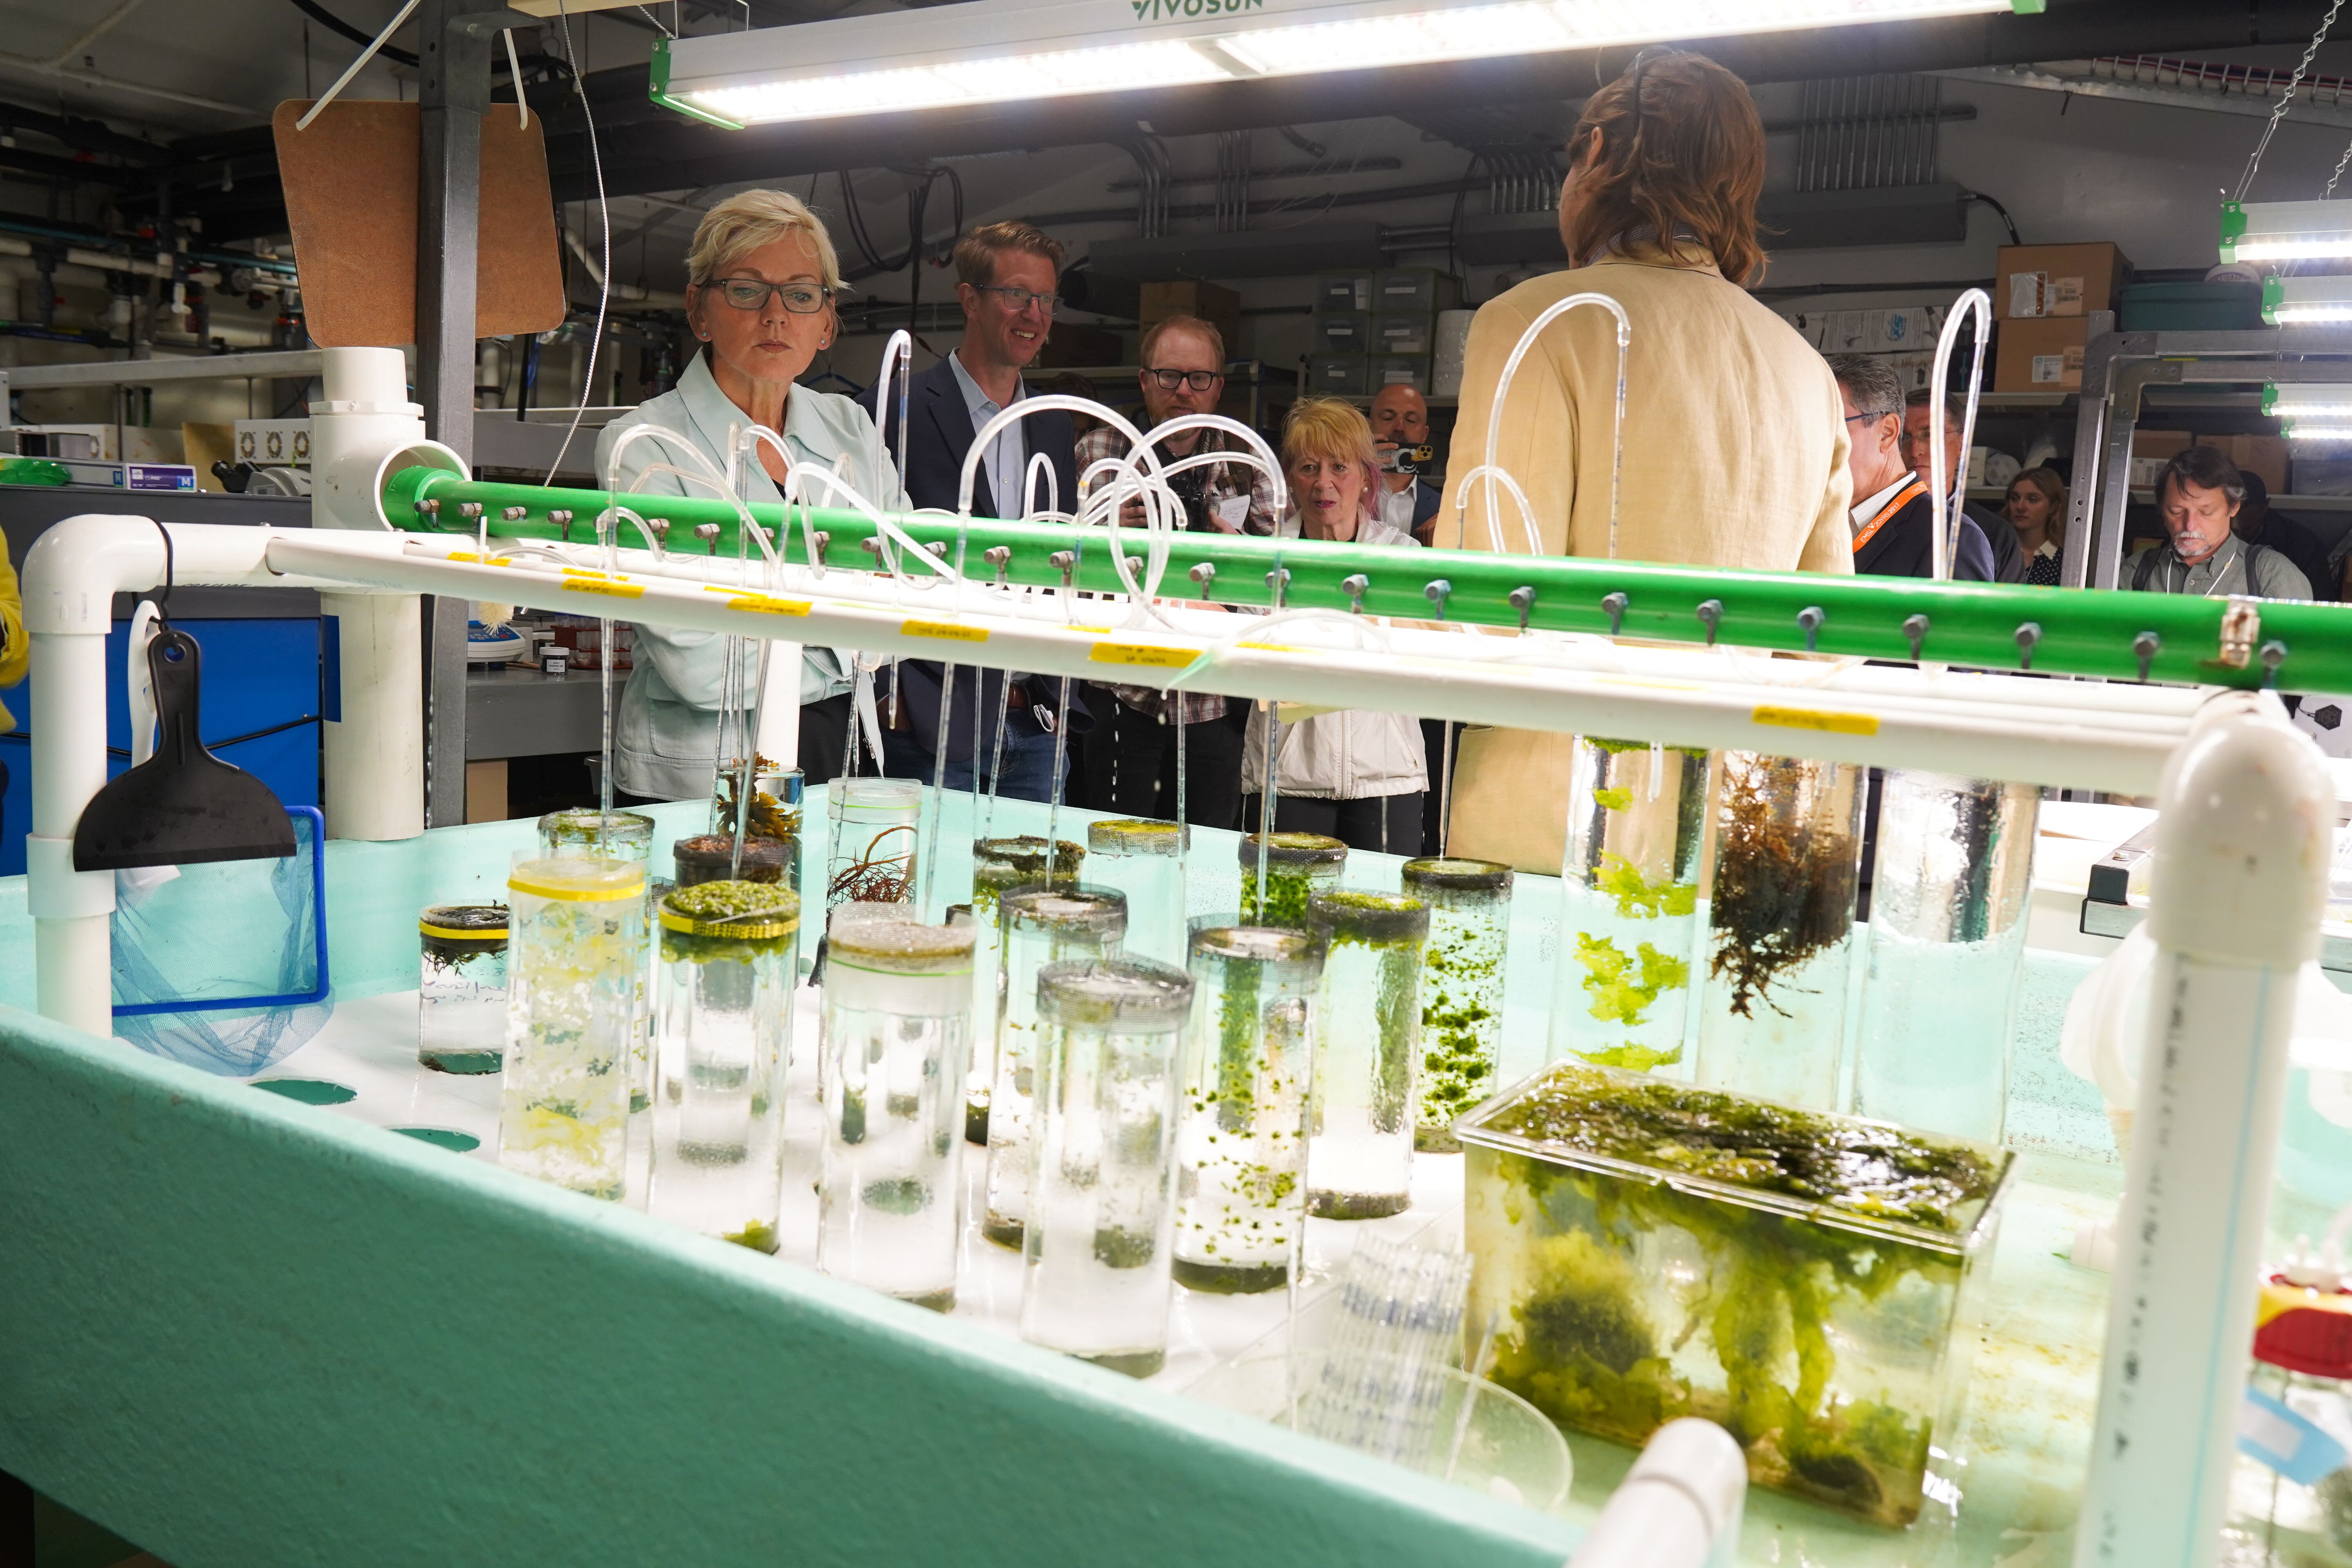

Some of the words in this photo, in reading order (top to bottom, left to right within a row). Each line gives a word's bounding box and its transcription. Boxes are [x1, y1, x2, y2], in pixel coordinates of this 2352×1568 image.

[181, 477, 191, 486] M
[1860, 529, 1875, 543] EMSL
[1888, 502, 1900, 514] 2017
